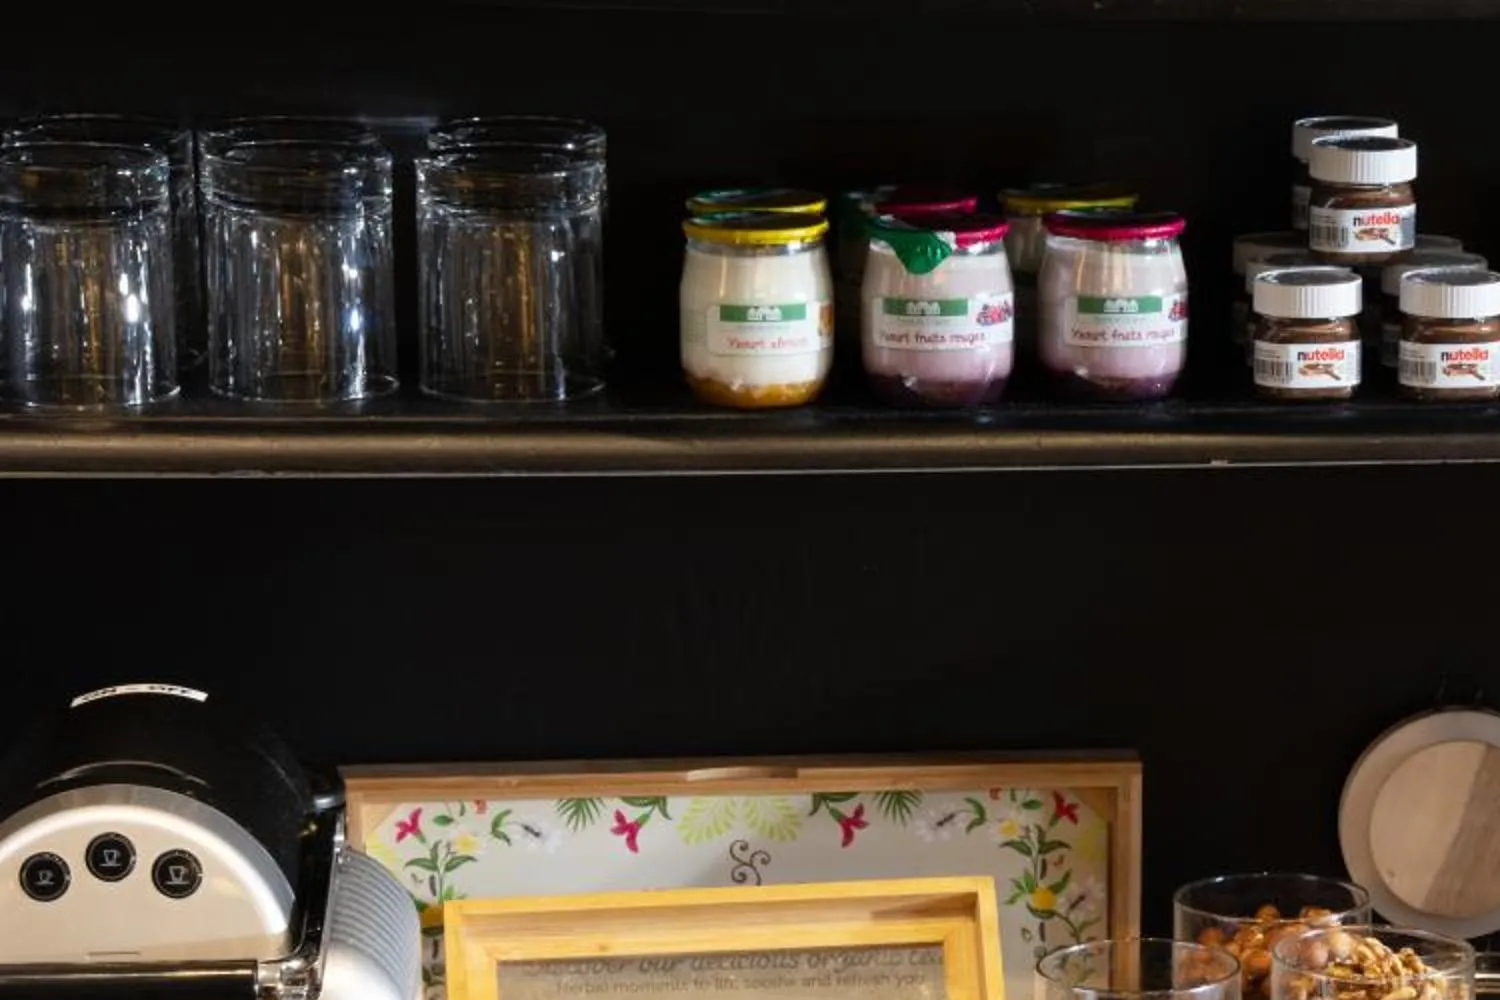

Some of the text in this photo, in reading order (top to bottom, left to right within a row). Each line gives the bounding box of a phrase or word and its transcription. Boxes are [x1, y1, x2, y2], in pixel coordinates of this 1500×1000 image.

[1352, 212, 1400, 227] nutella
[1297, 348, 1345, 361] nutella
[1441, 347, 1489, 361] nutella
